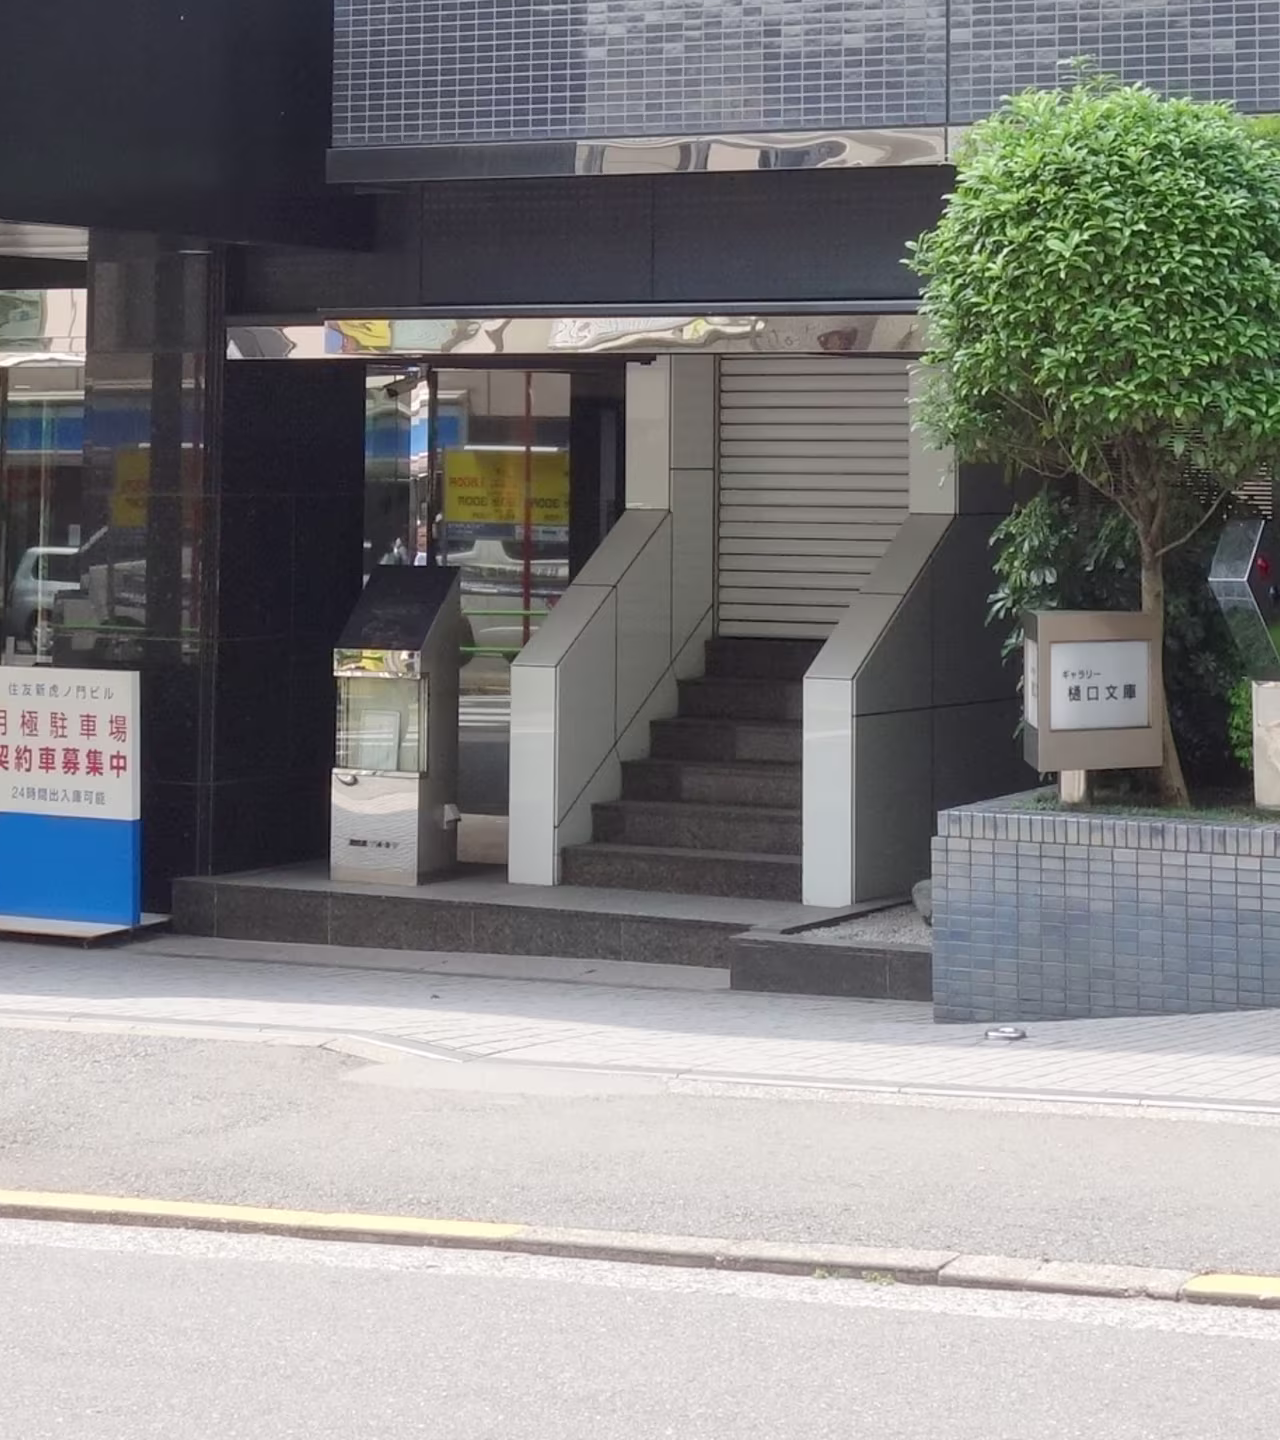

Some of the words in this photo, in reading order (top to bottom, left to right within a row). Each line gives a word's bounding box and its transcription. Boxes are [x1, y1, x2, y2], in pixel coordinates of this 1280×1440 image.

[1062, 669, 1102, 680] ギャラリー
[8, 682, 115, 701] 住友新虎ノ門ビル
[1068, 683, 1137, 702] 樋口文庫
[11, 786, 107, 806] 24時間出入庫可能
